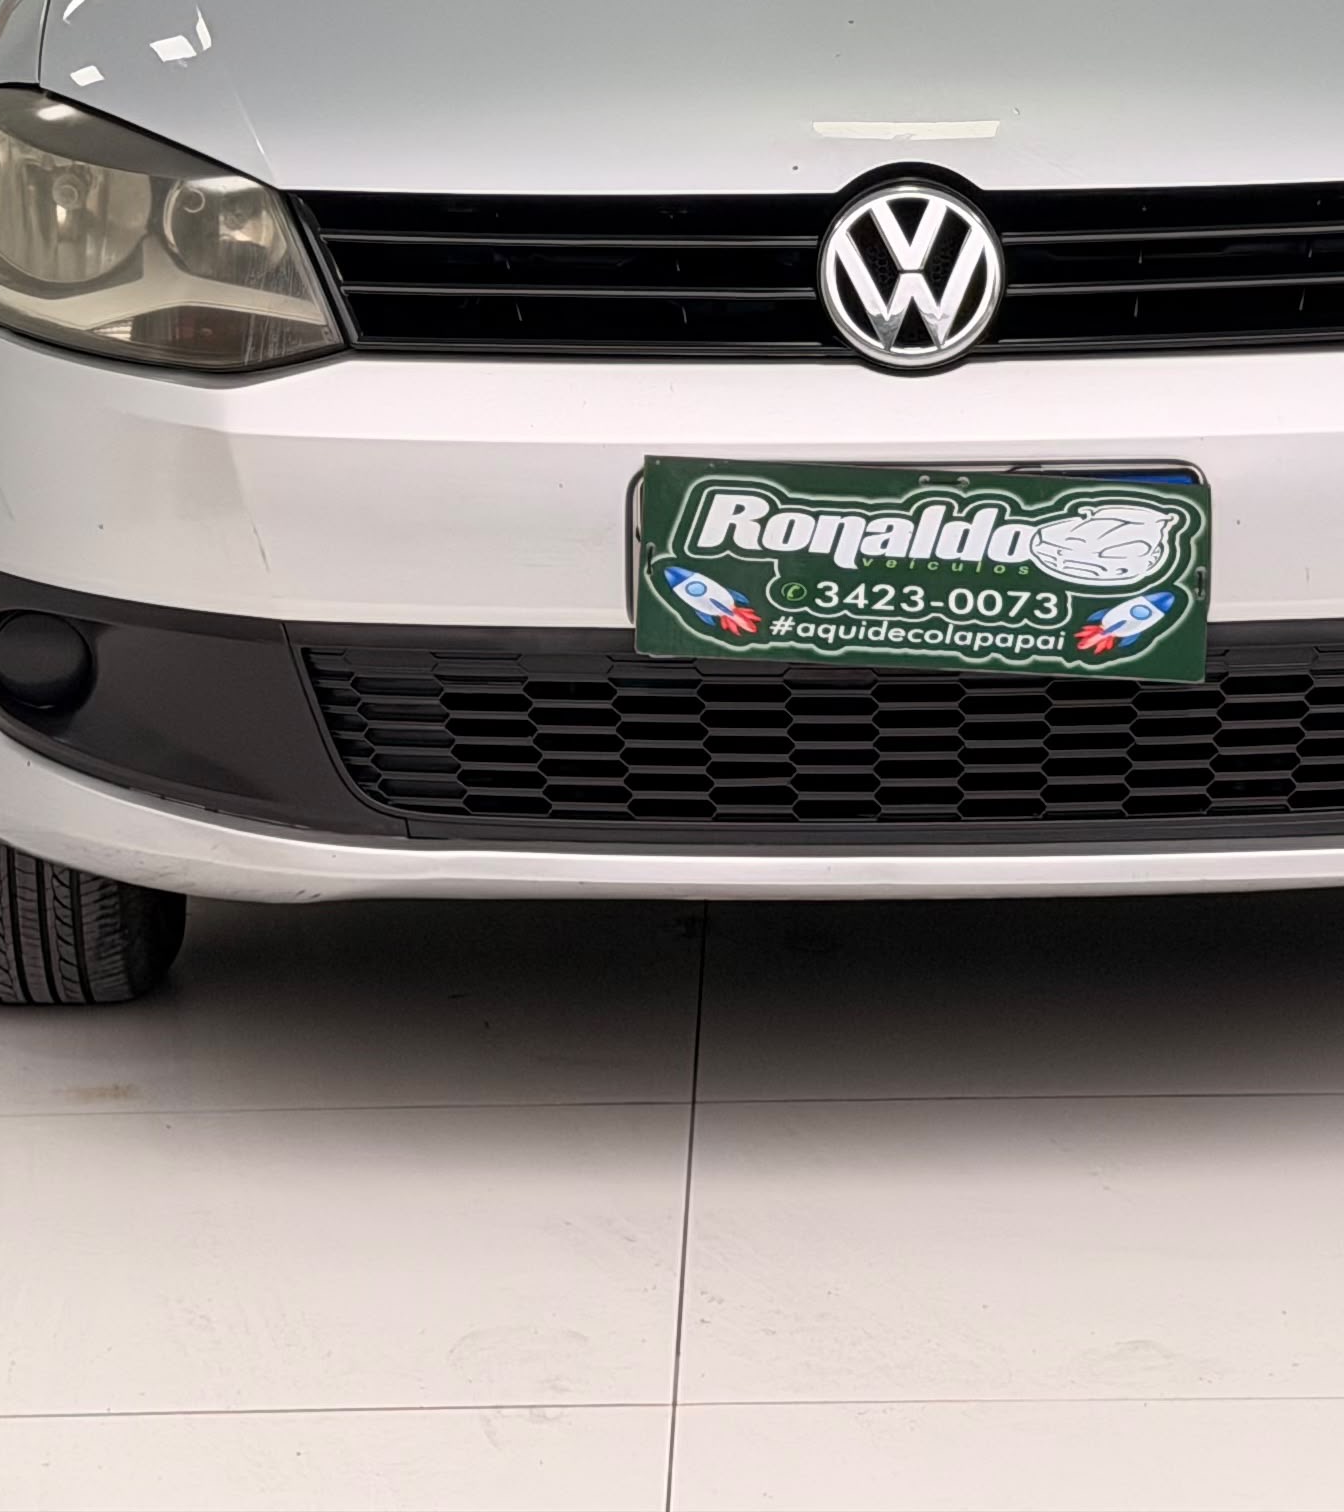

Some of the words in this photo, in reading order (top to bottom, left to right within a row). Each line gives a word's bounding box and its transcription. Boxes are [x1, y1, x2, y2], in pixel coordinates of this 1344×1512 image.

[824, 190, 996, 356] VW
[696, 493, 1041, 570] Ronaldo
[813, 581, 1059, 620] 3423-0073
[769, 615, 1067, 654] #aquidecolapapai
